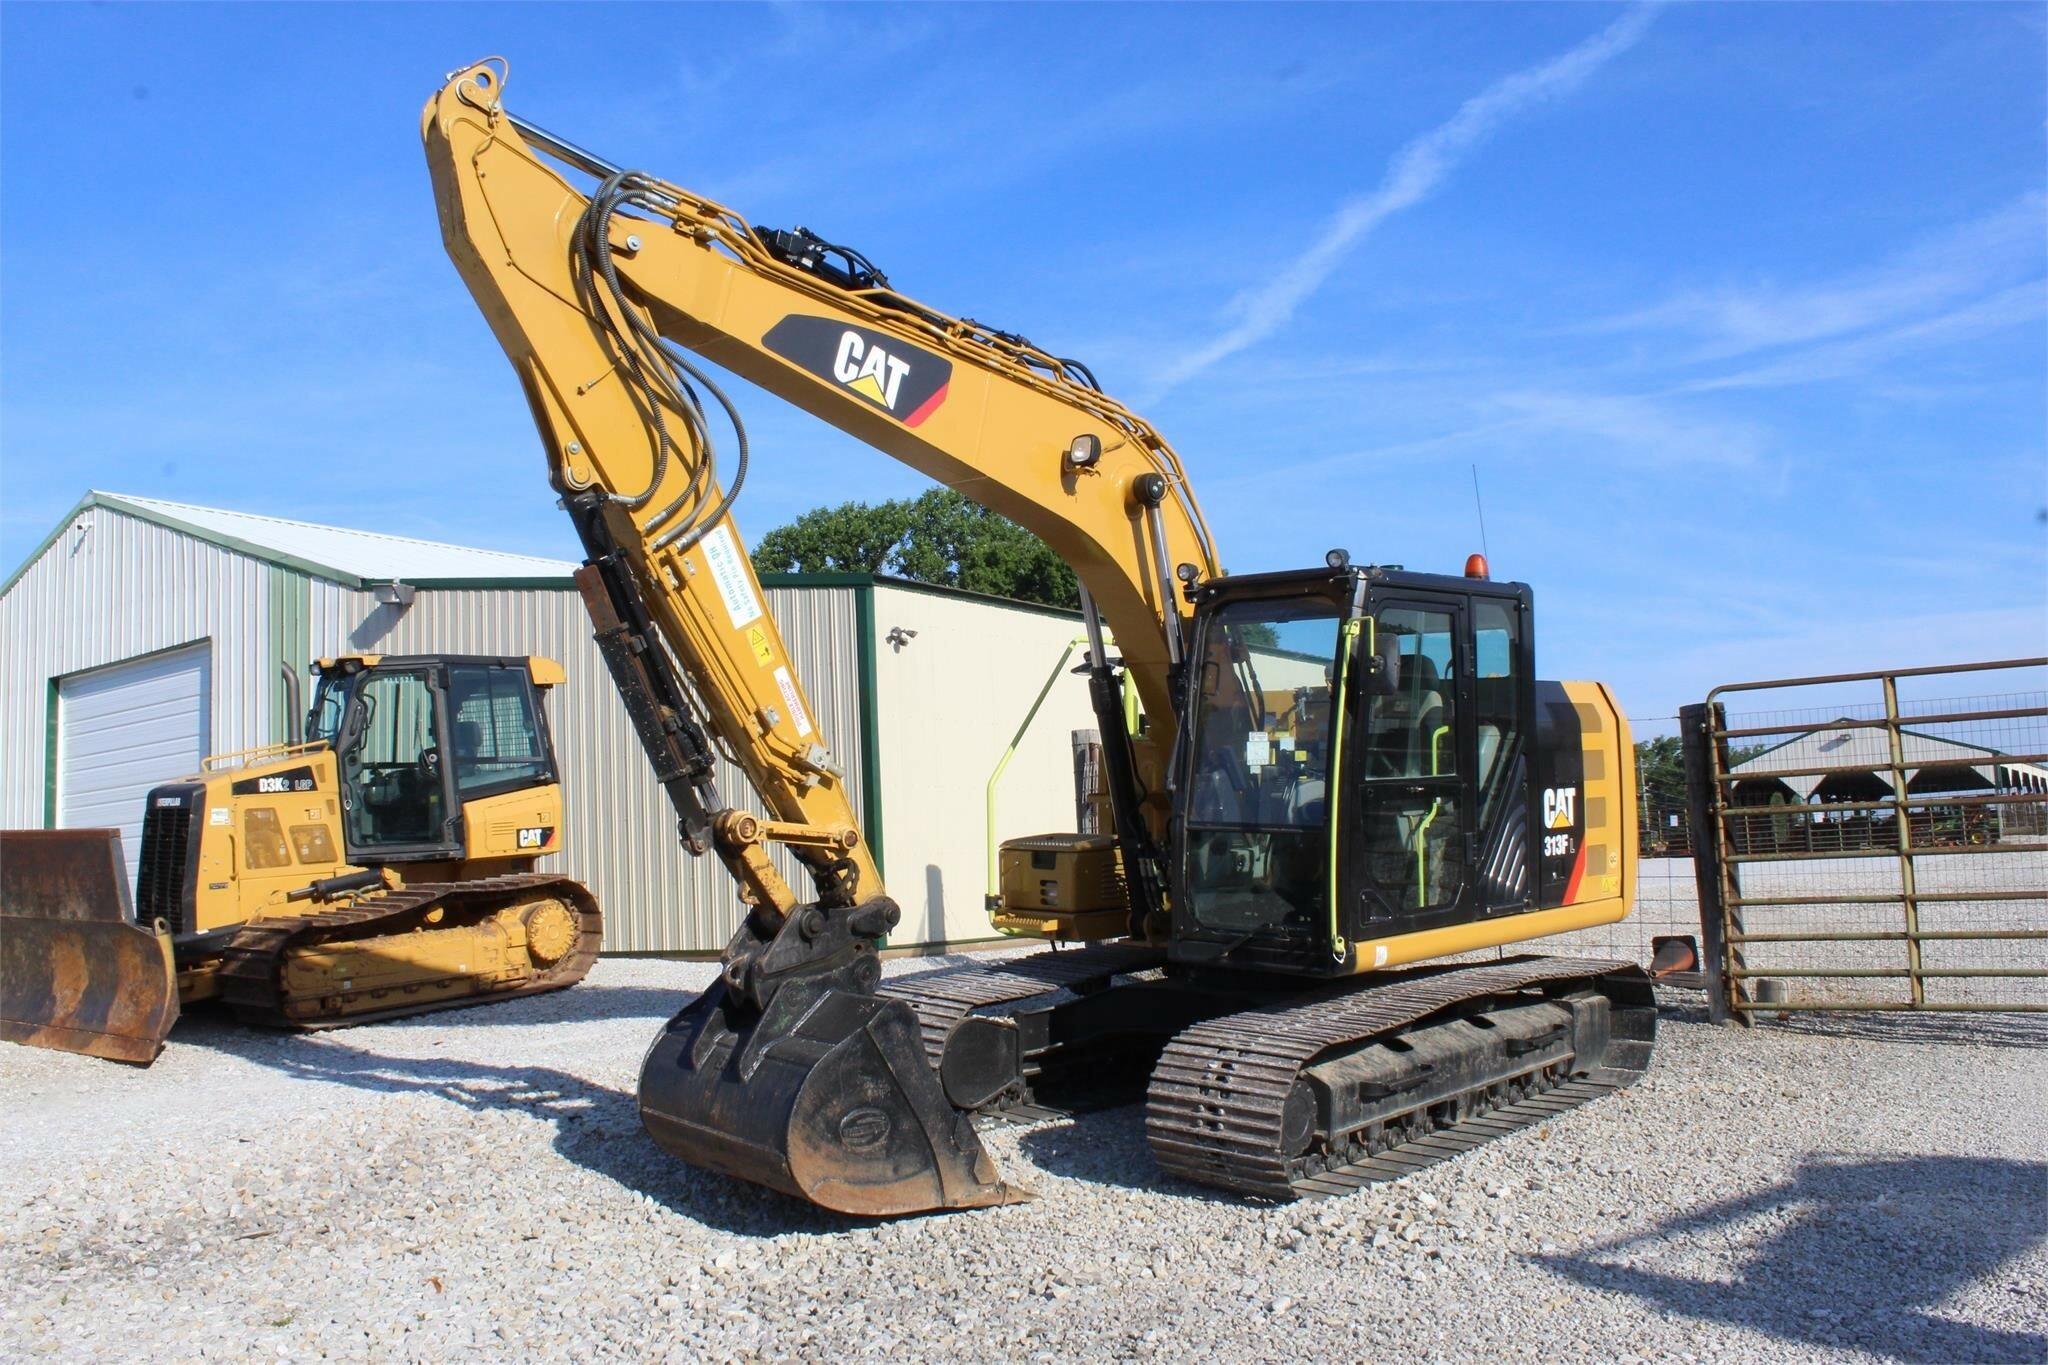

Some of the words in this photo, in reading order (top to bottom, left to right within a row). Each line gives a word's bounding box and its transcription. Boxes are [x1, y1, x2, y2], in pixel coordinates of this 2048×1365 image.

[833, 330, 911, 411] CAT
[715, 529, 734, 564] Required
[717, 561, 741, 611] Automatic
[730, 565, 740, 579] Pin
[736, 579, 751, 605] Safety
[1543, 788, 1576, 829] CAT
[519, 829, 542, 847] CAT
[1544, 834, 1568, 857] 313F
[1569, 838, 1575, 854] L
